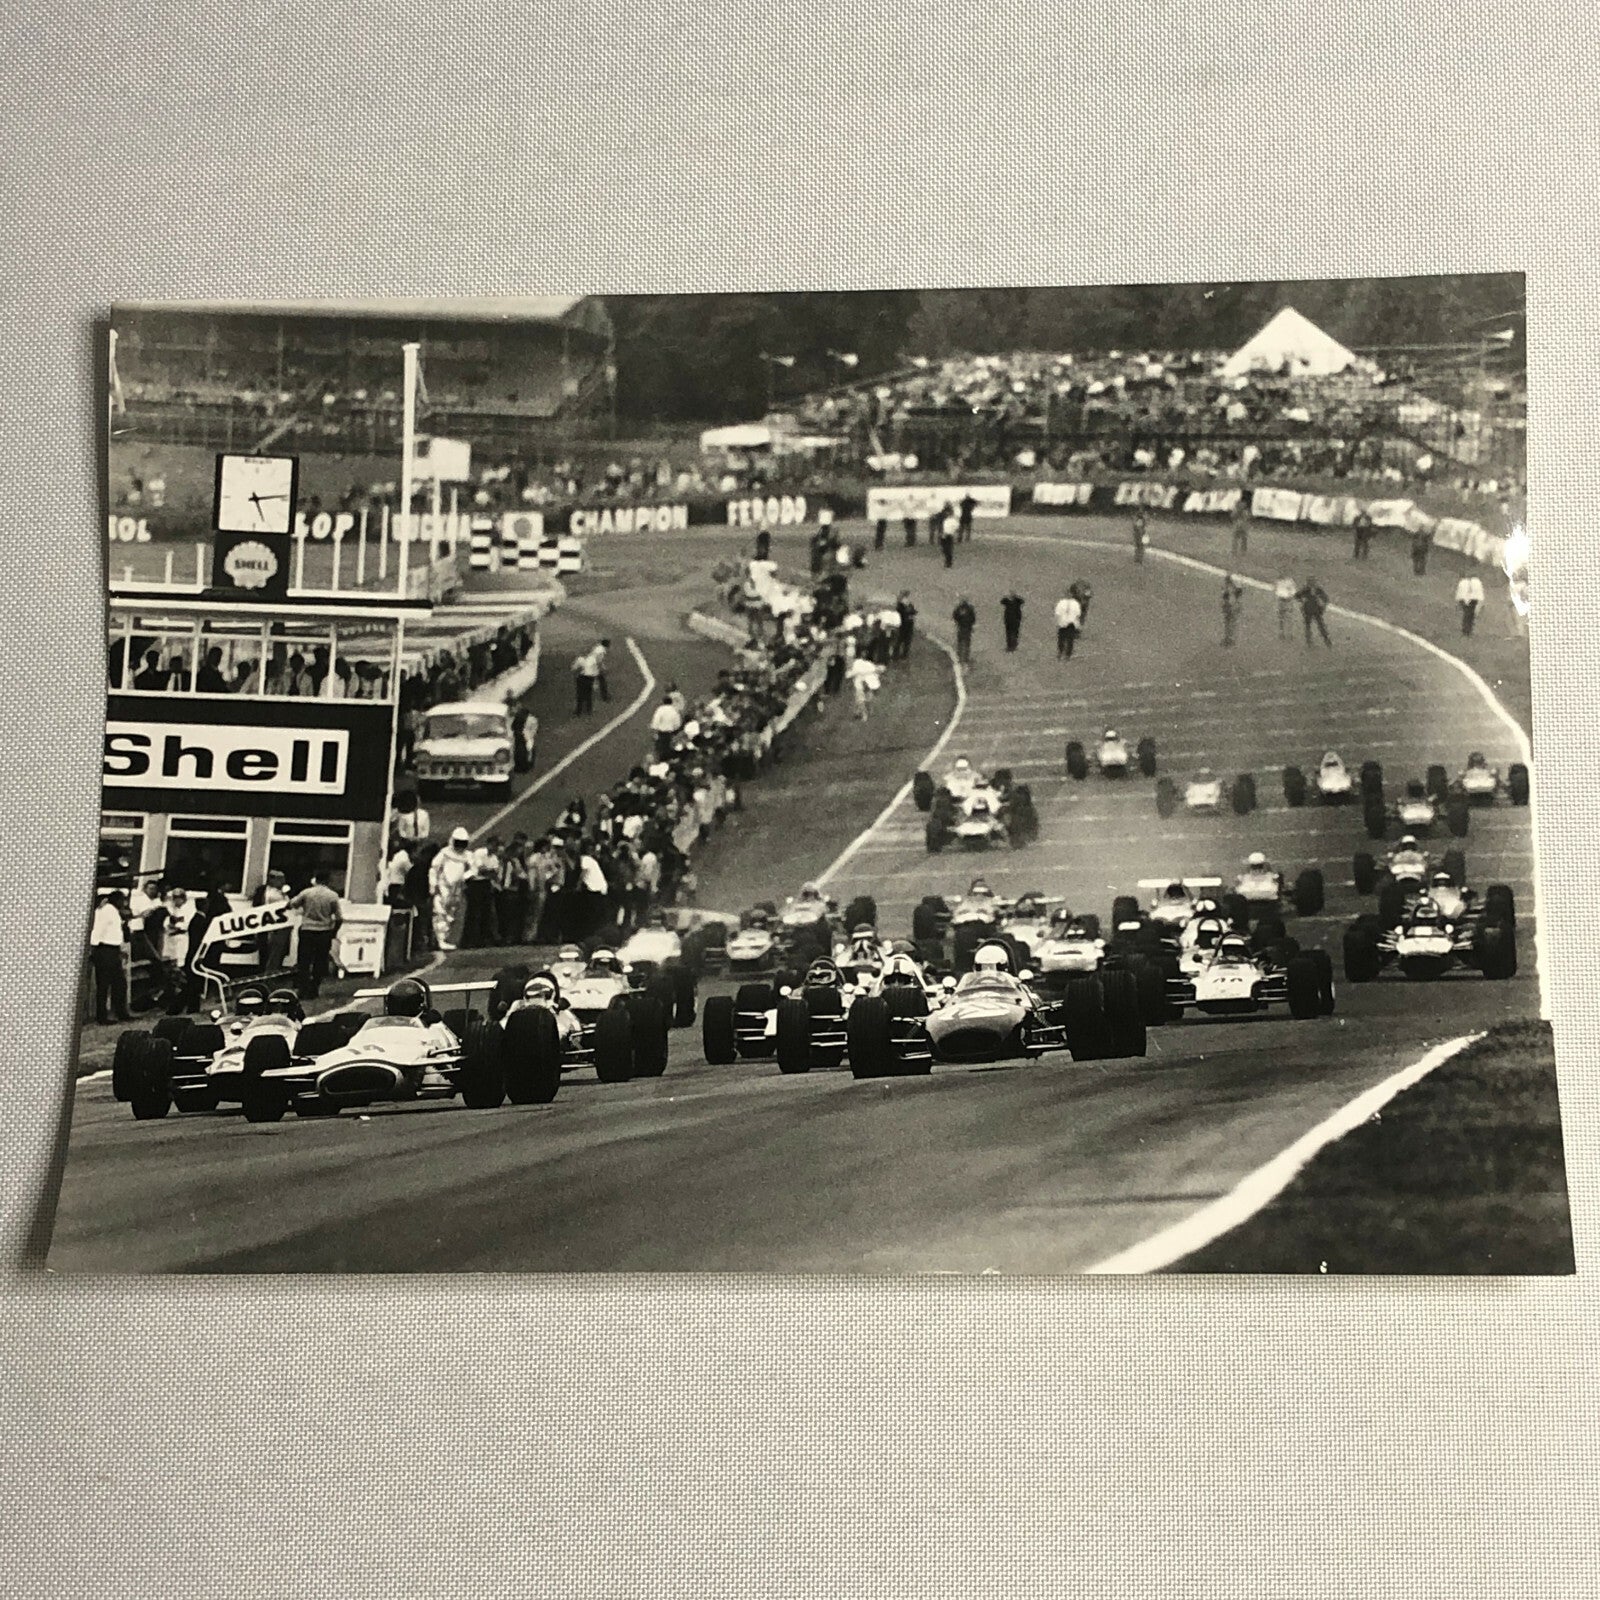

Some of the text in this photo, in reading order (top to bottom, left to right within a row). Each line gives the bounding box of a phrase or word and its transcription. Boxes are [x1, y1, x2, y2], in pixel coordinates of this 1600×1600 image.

[569, 505, 688, 535] CHAMPION
[103, 733, 339, 783] Shell
[219, 907, 289, 935] LUCAS
